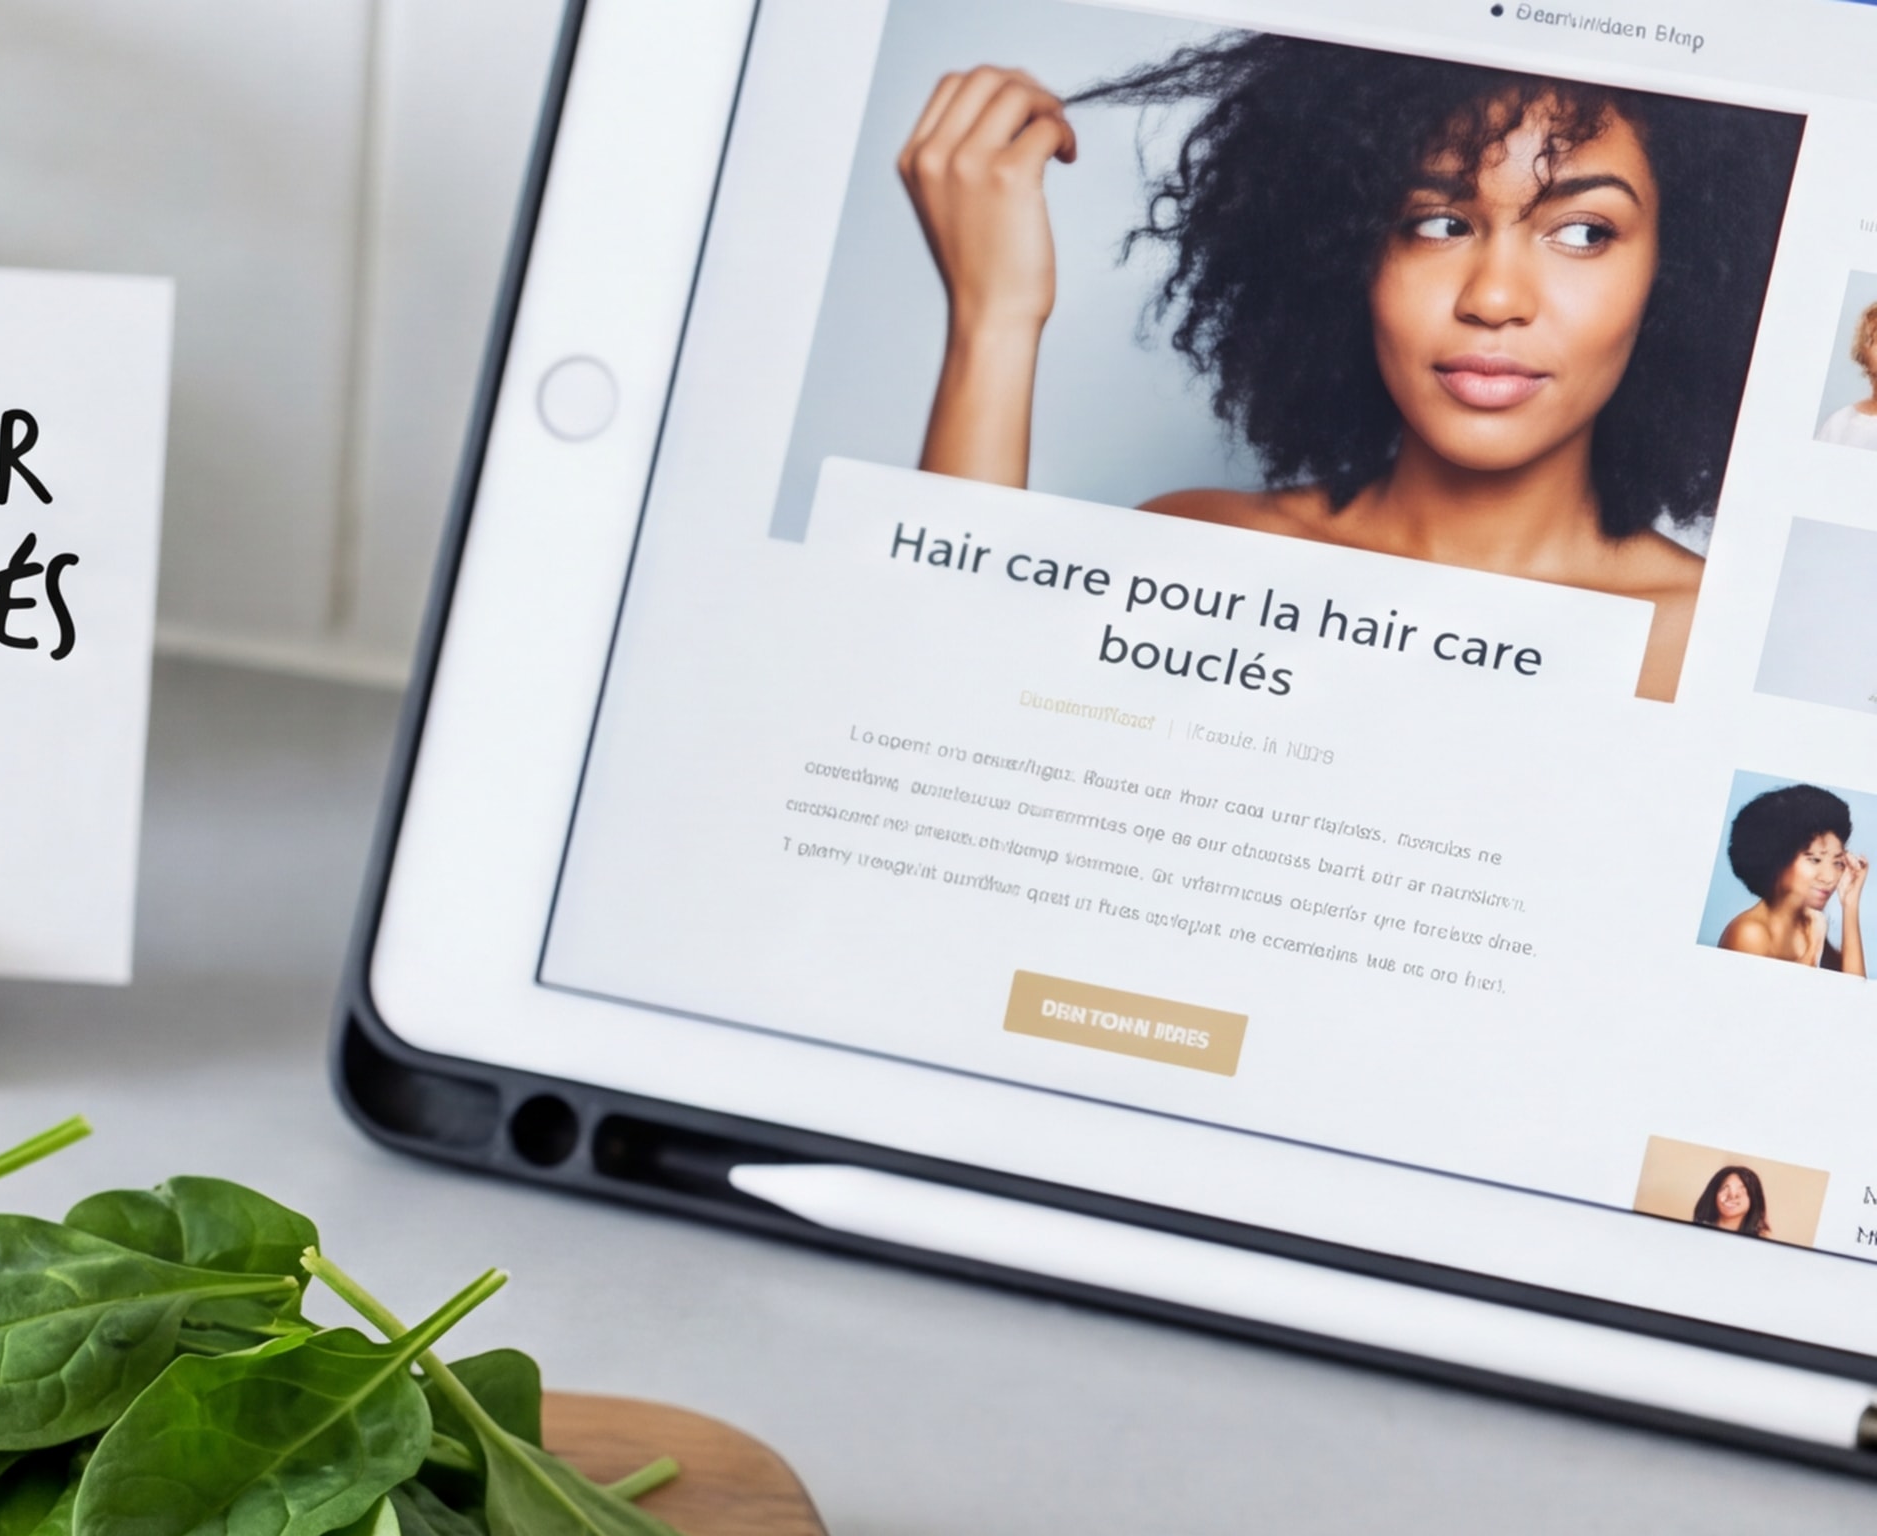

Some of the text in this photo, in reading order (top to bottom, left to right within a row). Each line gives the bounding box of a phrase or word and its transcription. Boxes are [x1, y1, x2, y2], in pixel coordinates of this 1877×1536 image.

[890, 522, 1543, 677] Hair care pour la hair care
[1098, 623, 1294, 697] bouclés
